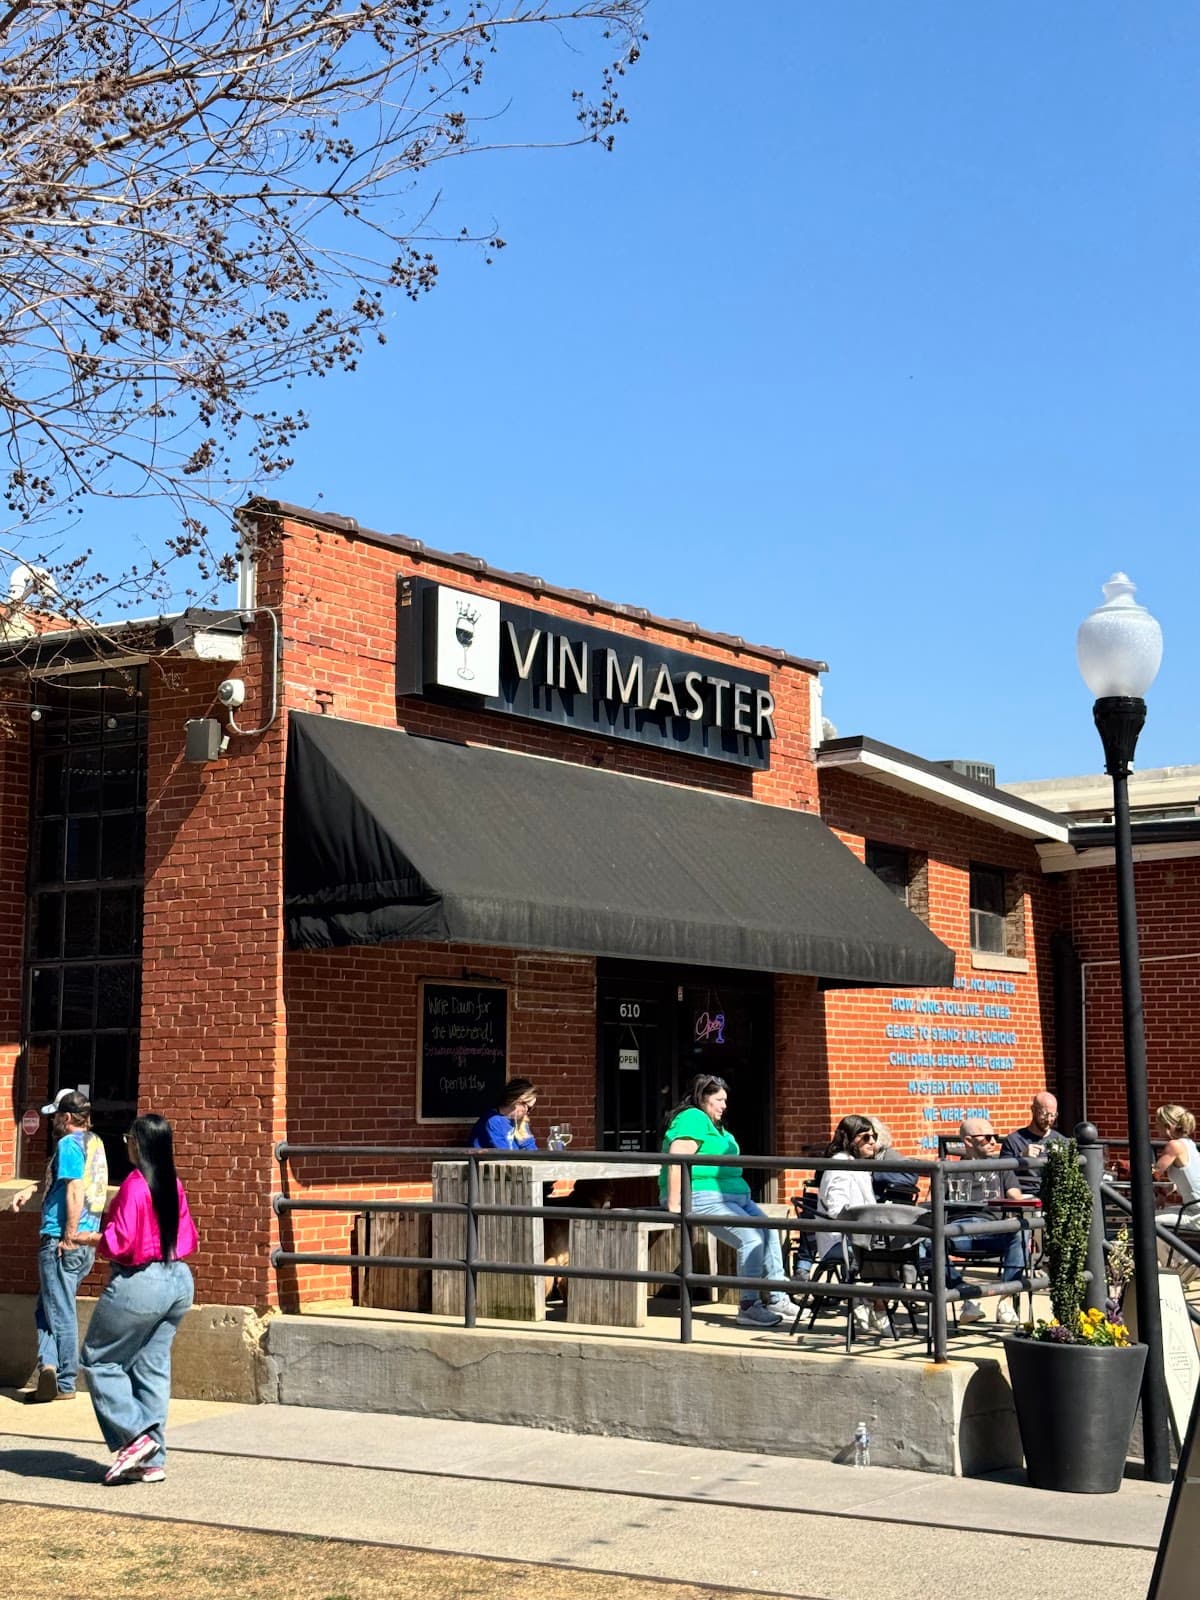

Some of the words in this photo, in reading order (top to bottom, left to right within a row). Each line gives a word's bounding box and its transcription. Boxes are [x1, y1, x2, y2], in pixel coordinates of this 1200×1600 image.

[504, 620, 588, 695] VIN
[606, 648, 777, 740] MASTER
[985, 980, 1015, 994] MATTER
[475, 992, 493, 1020] for
[620, 1003, 641, 1018] 610
[891, 998, 913, 1012] HOW
[915, 1000, 940, 1014] LONG
[942, 1002, 959, 1015] YOU
[984, 1005, 1010, 1019] NEVER
[695, 1012, 721, 1041] Open
[886, 1024, 915, 1039] CEASE
[918, 1025, 929, 1040] TO
[931, 1027, 959, 1042] STAND
[962, 1030, 979, 1043] LIKE
[981, 1031, 1016, 1045] CURIOUS
[619, 1055, 638, 1065] OPEN
[889, 1052, 934, 1067] CHILDREN
[937, 1053, 970, 1068] BEFORE
[972, 1055, 987, 1069] THE
[989, 1056, 1015, 1070] GREAT
[908, 1080, 947, 1095] MYSTERY
[950, 1081, 971, 1095] INTO
[973, 1082, 1000, 1096] WHICH
[923, 1107, 938, 1121] WE
[939, 1108, 963, 1121] WERE
